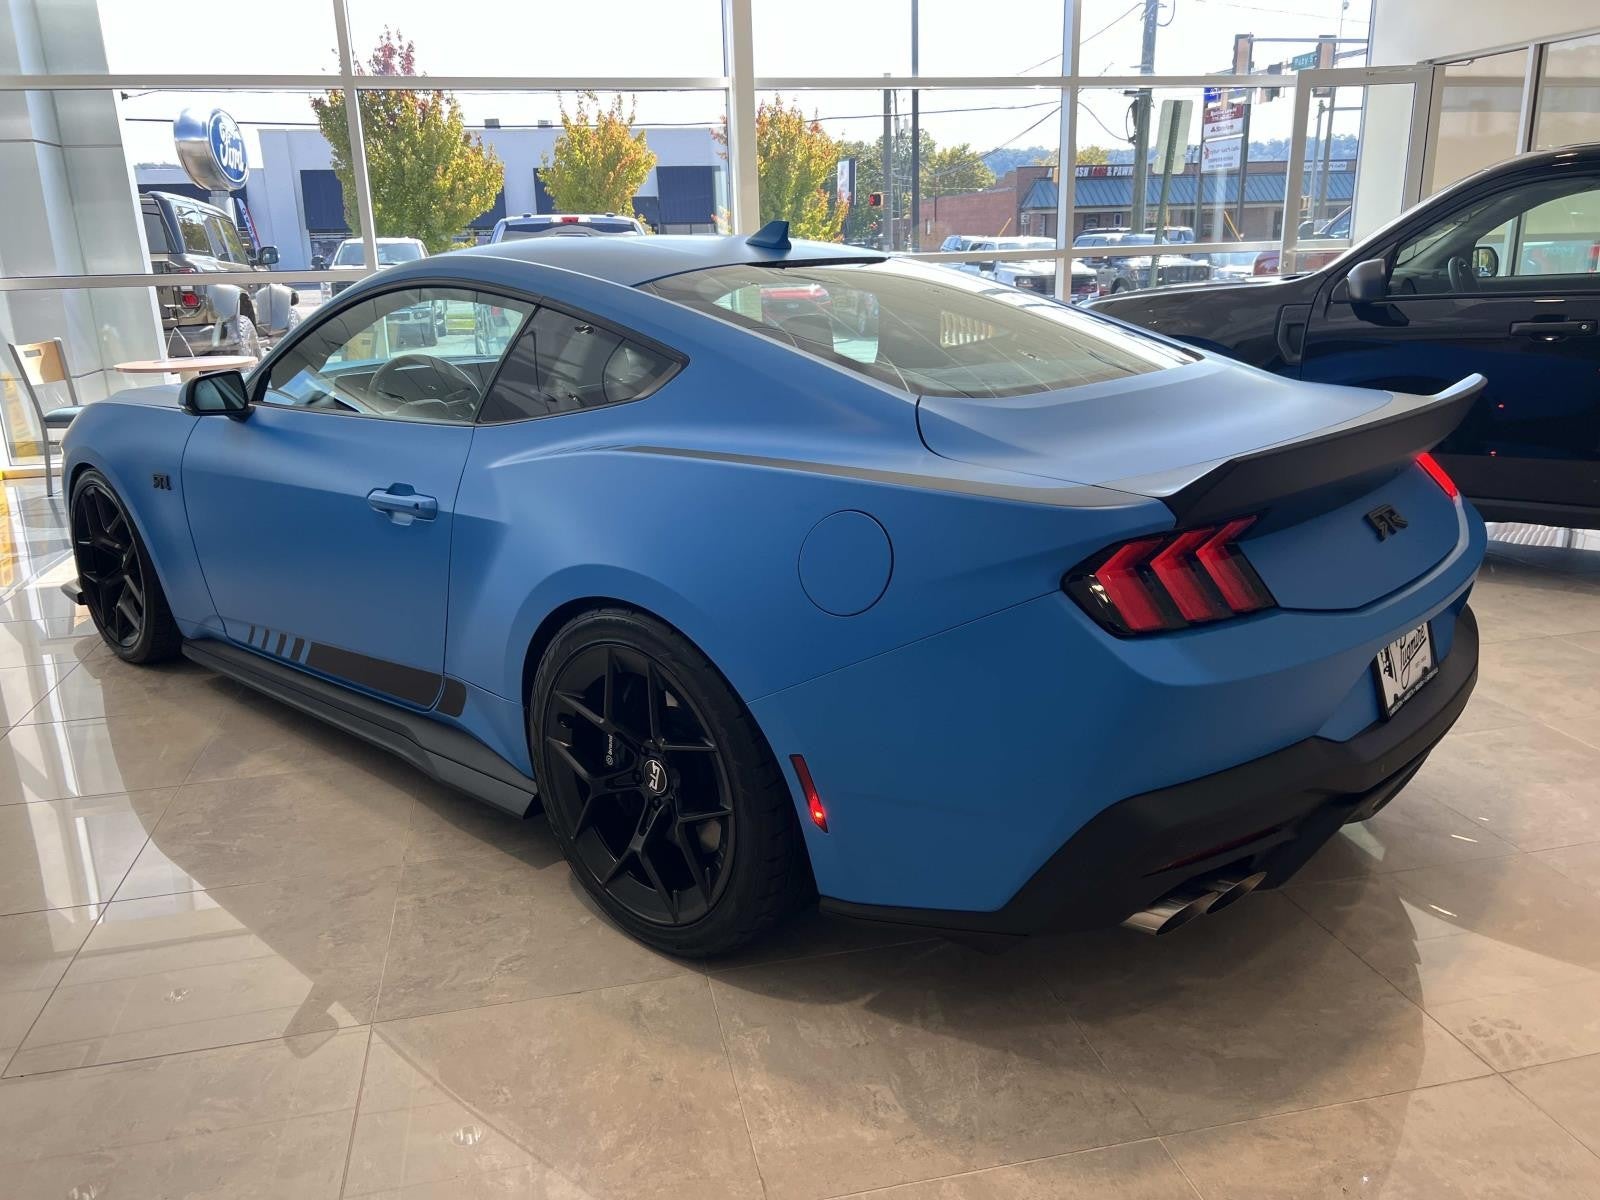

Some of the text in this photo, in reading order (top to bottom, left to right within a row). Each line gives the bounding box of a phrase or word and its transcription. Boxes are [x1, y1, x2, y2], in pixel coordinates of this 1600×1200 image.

[219, 122, 244, 173] Ford
[1075, 166, 1090, 177] ASH
[1113, 166, 1133, 177] PAWN
